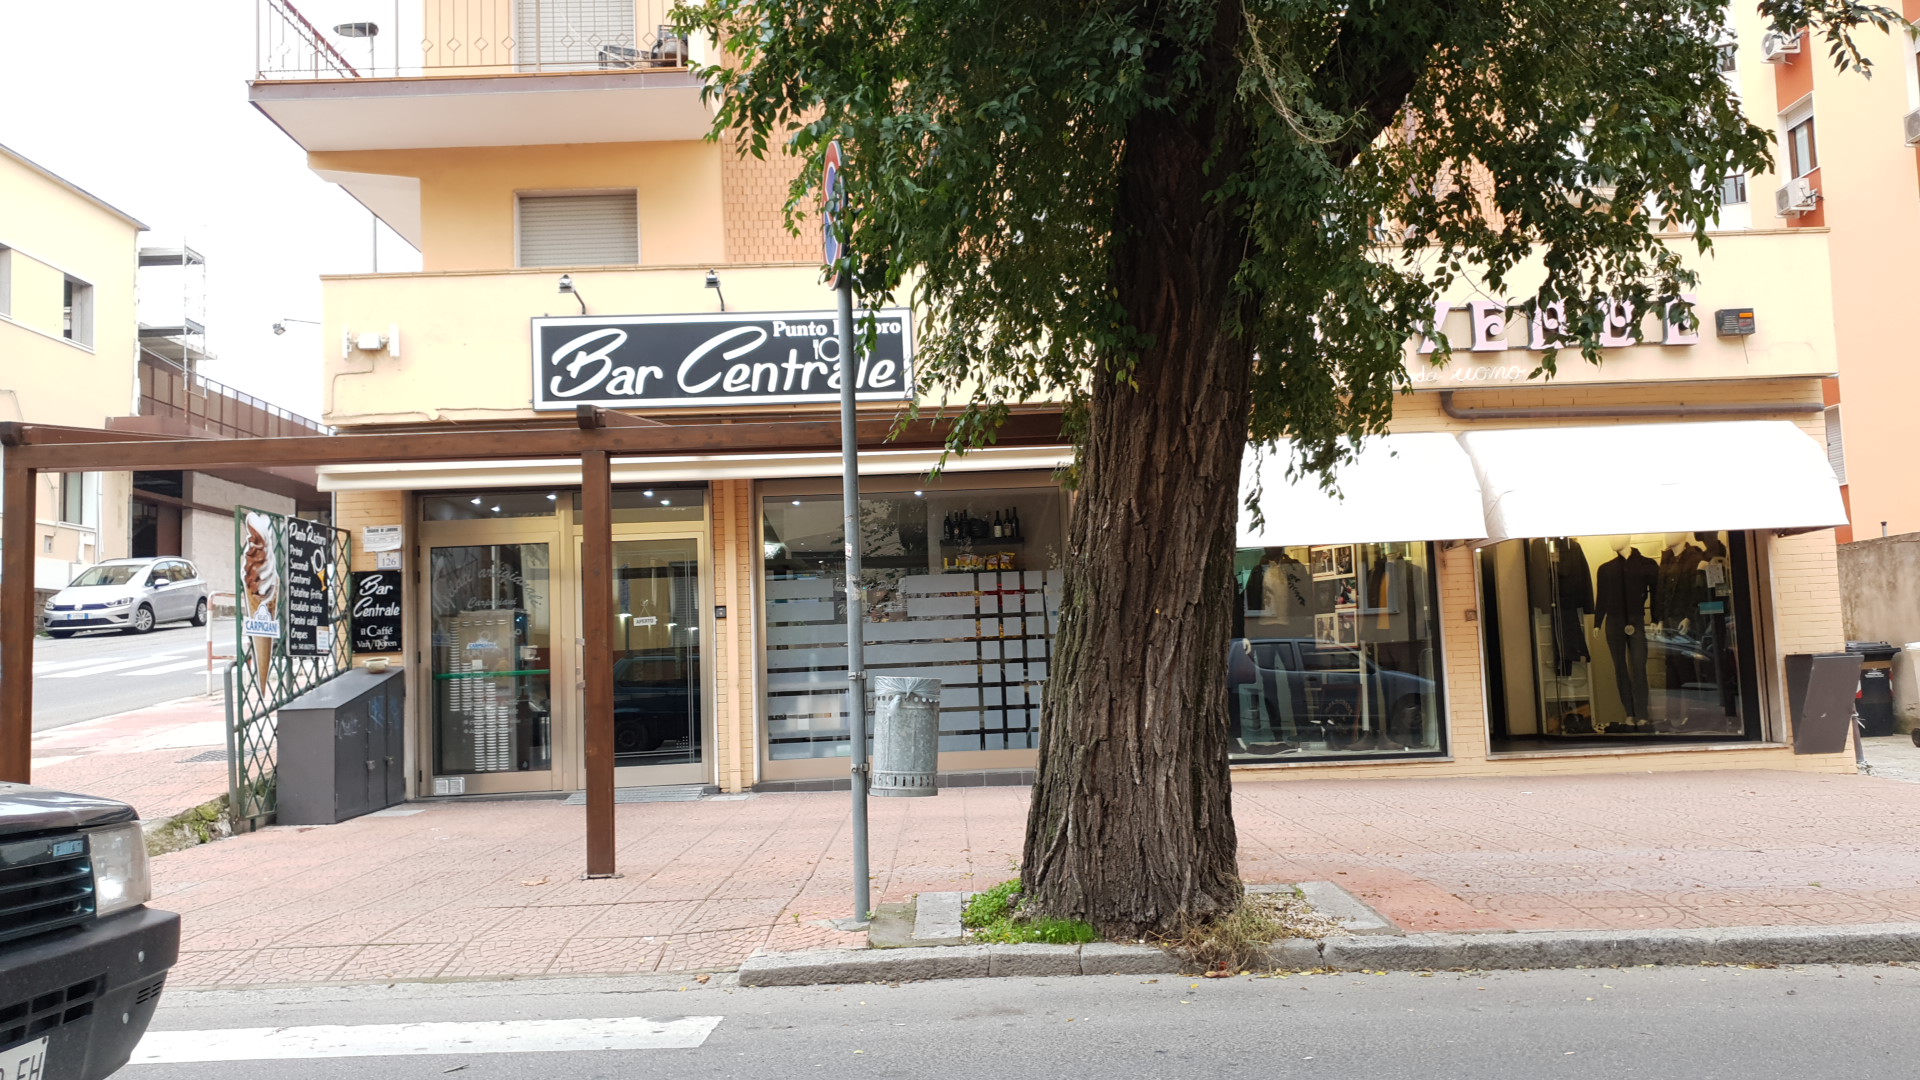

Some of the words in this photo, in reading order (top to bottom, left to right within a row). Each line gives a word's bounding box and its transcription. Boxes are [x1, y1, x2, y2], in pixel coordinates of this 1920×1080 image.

[772, 320, 828, 337] Punto
[832, 319, 901, 337] stro
[550, 327, 663, 397] Bar
[677, 326, 896, 393] Centrale
[1450, 365, 1527, 381] uomo
[289, 522, 307, 541] Punto
[306, 525, 326, 545] Ristoro
[290, 544, 303, 557] Primi
[290, 558, 309, 571] Secondi
[382, 557, 397, 567] 126
[290, 572, 311, 585] Contorni
[359, 574, 394, 596] Bar
[353, 596, 400, 618] Centrale
[245, 620, 278, 632] CARPIGIANI
[290, 613, 306, 625] Panini
